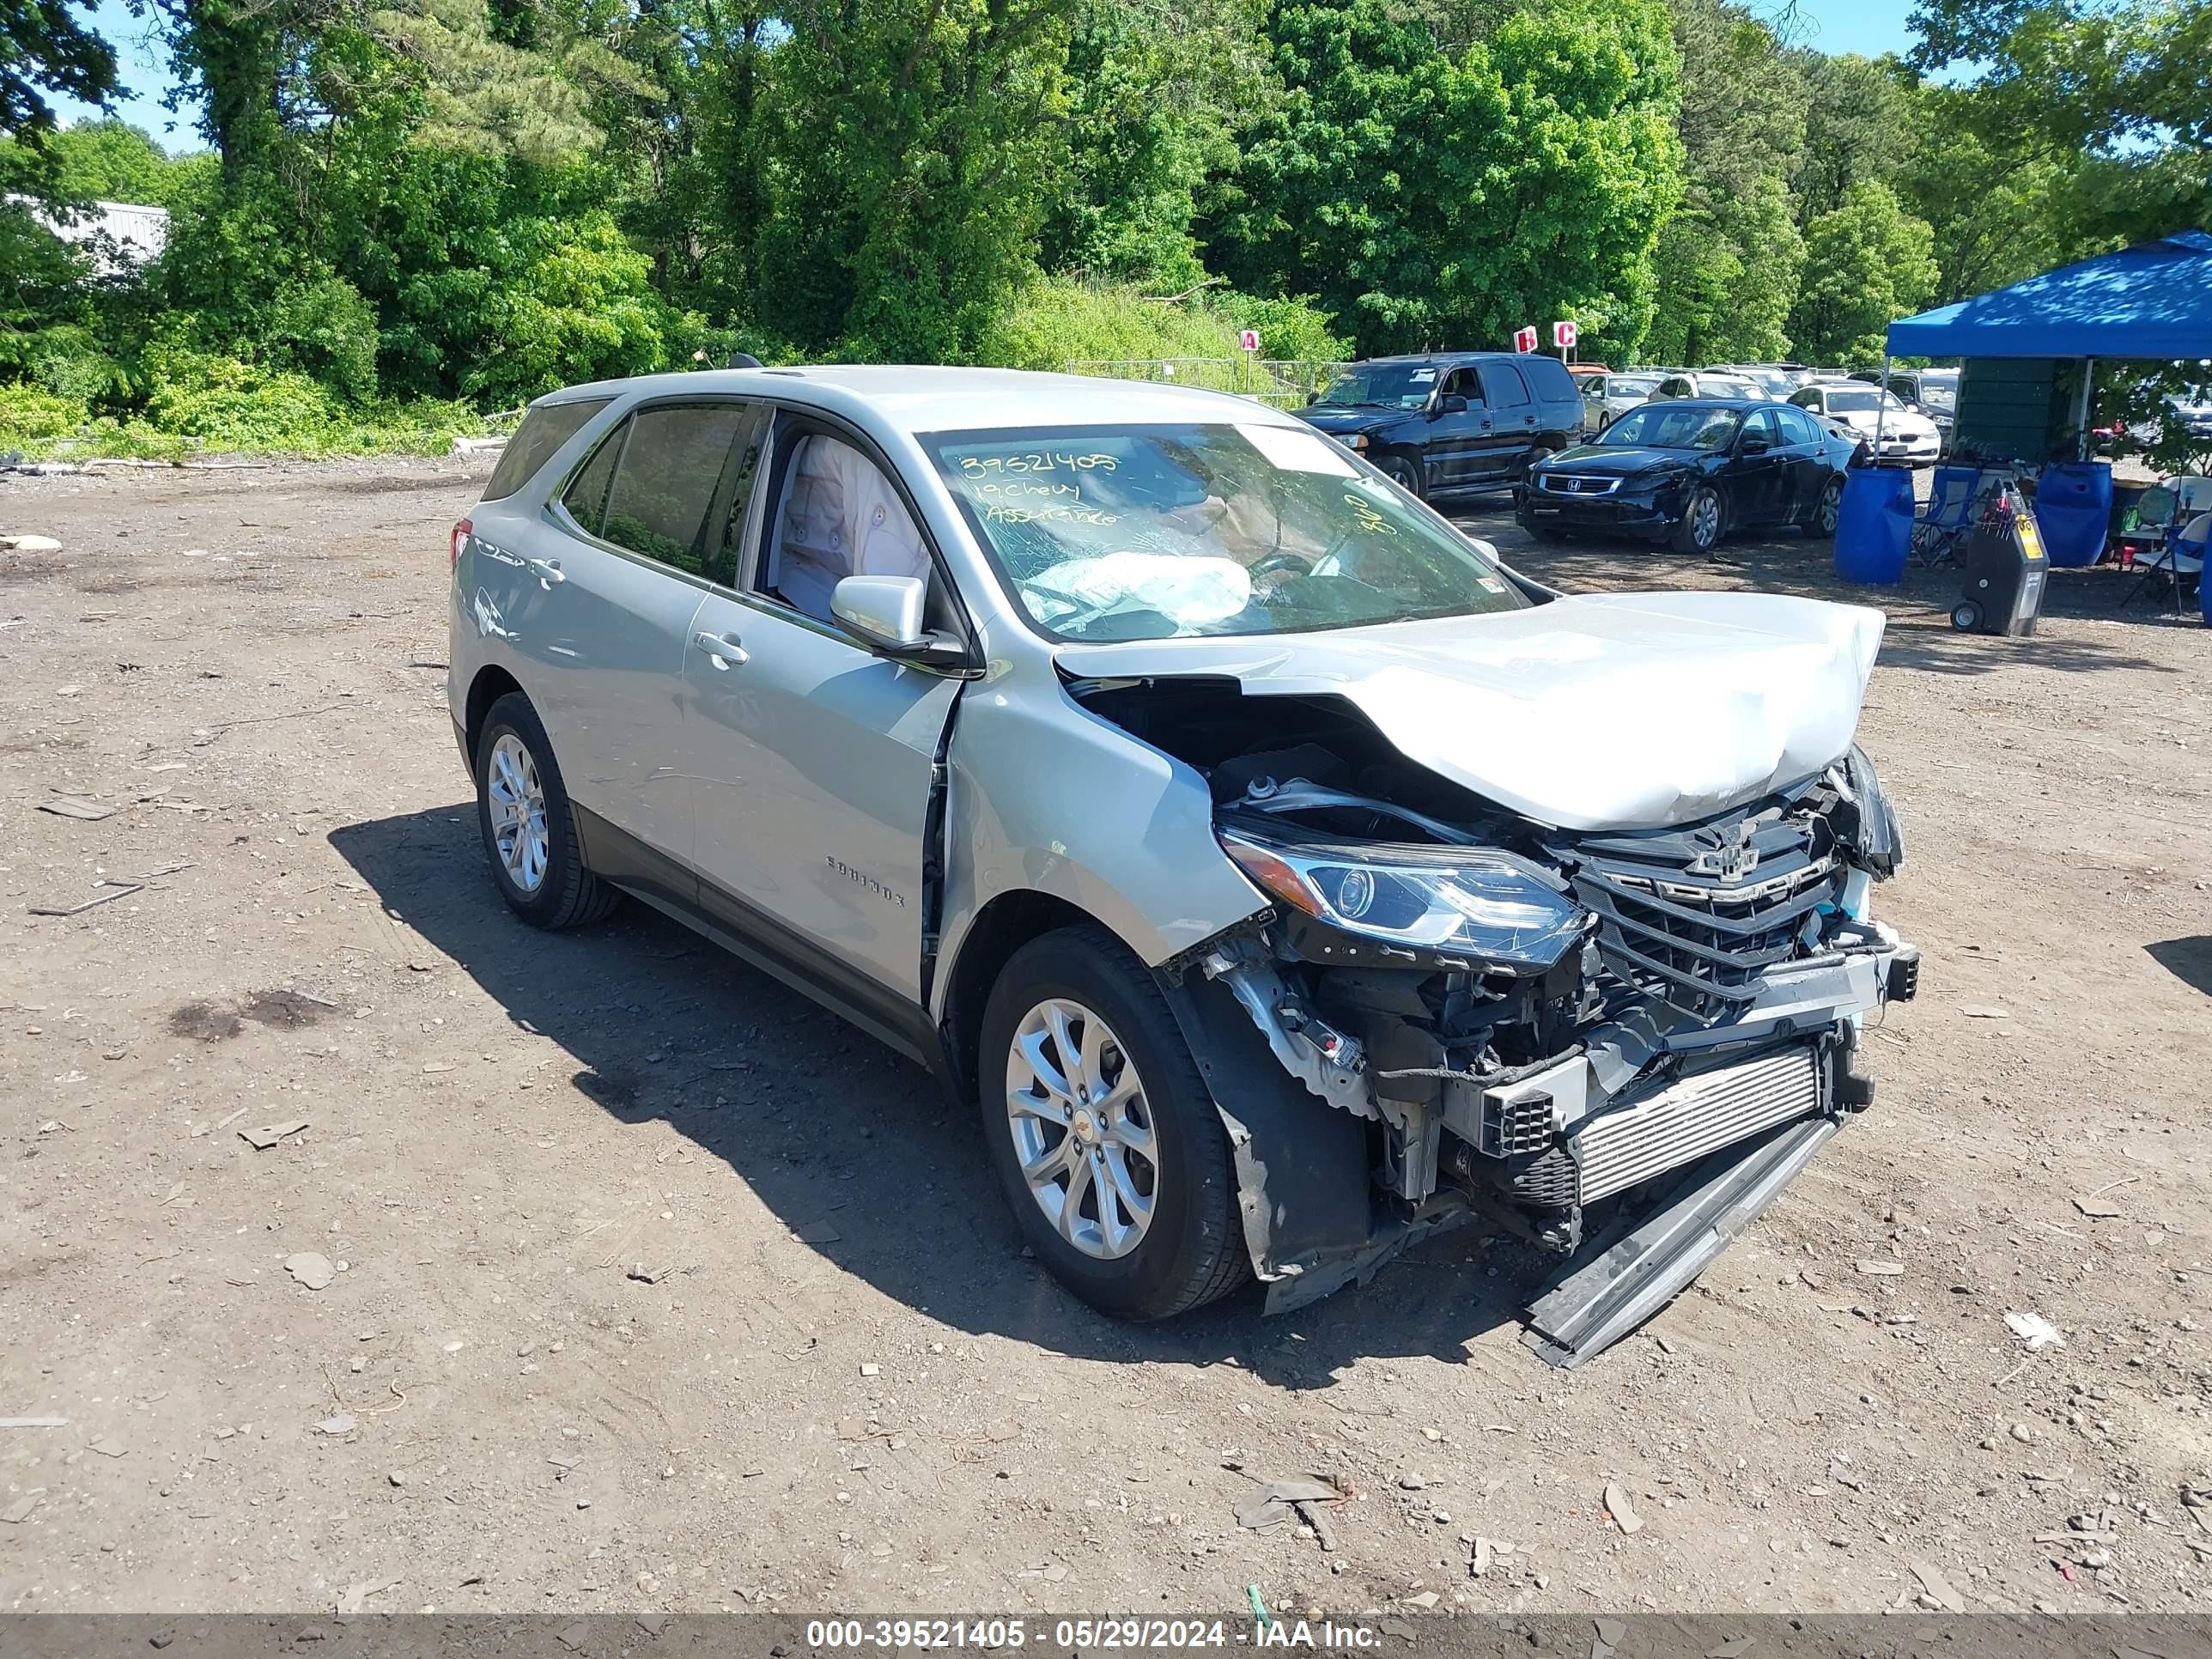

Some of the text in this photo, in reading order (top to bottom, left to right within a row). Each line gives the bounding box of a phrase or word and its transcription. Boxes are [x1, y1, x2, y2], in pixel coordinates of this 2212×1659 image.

[1242, 331, 1255, 349] A
[1517, 330, 1535, 352] B
[1558, 323, 1574, 345] C
[959, 452, 1121, 479] 39521405
[824, 855, 906, 908] EQUINOX
